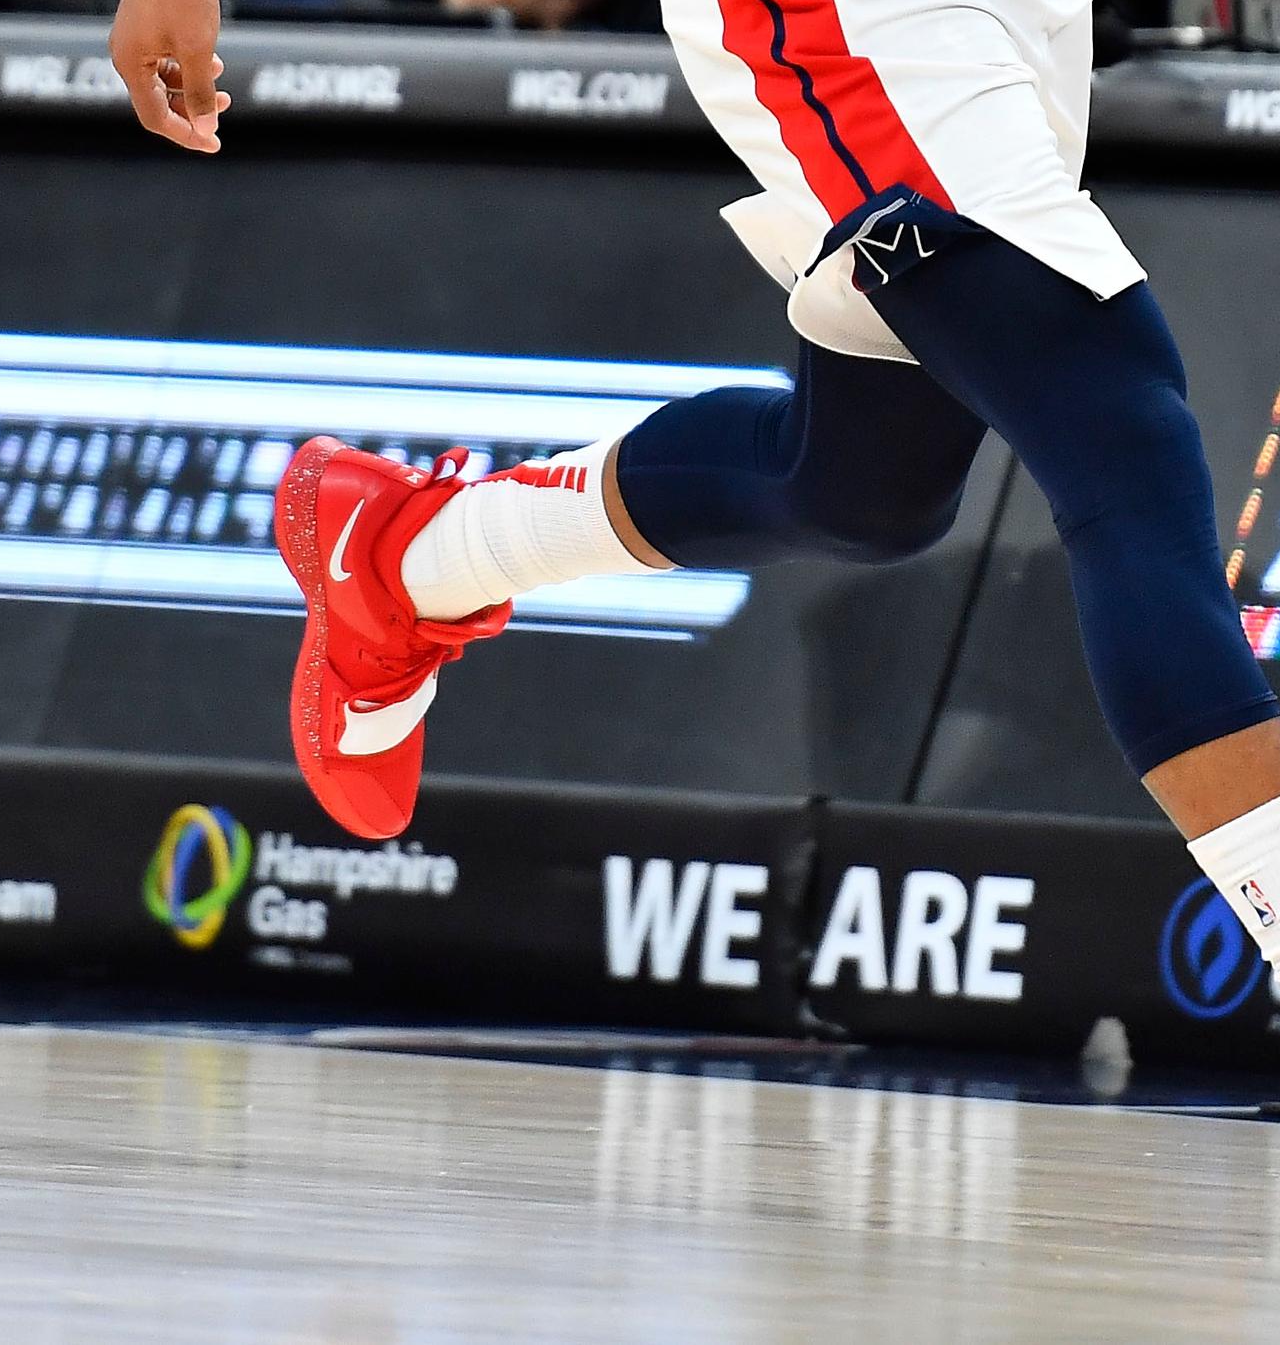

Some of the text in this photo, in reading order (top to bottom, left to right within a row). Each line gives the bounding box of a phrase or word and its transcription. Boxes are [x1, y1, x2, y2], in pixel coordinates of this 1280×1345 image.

[508, 70, 670, 115] WGL.COM
[255, 832, 459, 901] Hampshire
[248, 888, 328, 941] Gas
[603, 854, 1036, 1000] WE ARE
